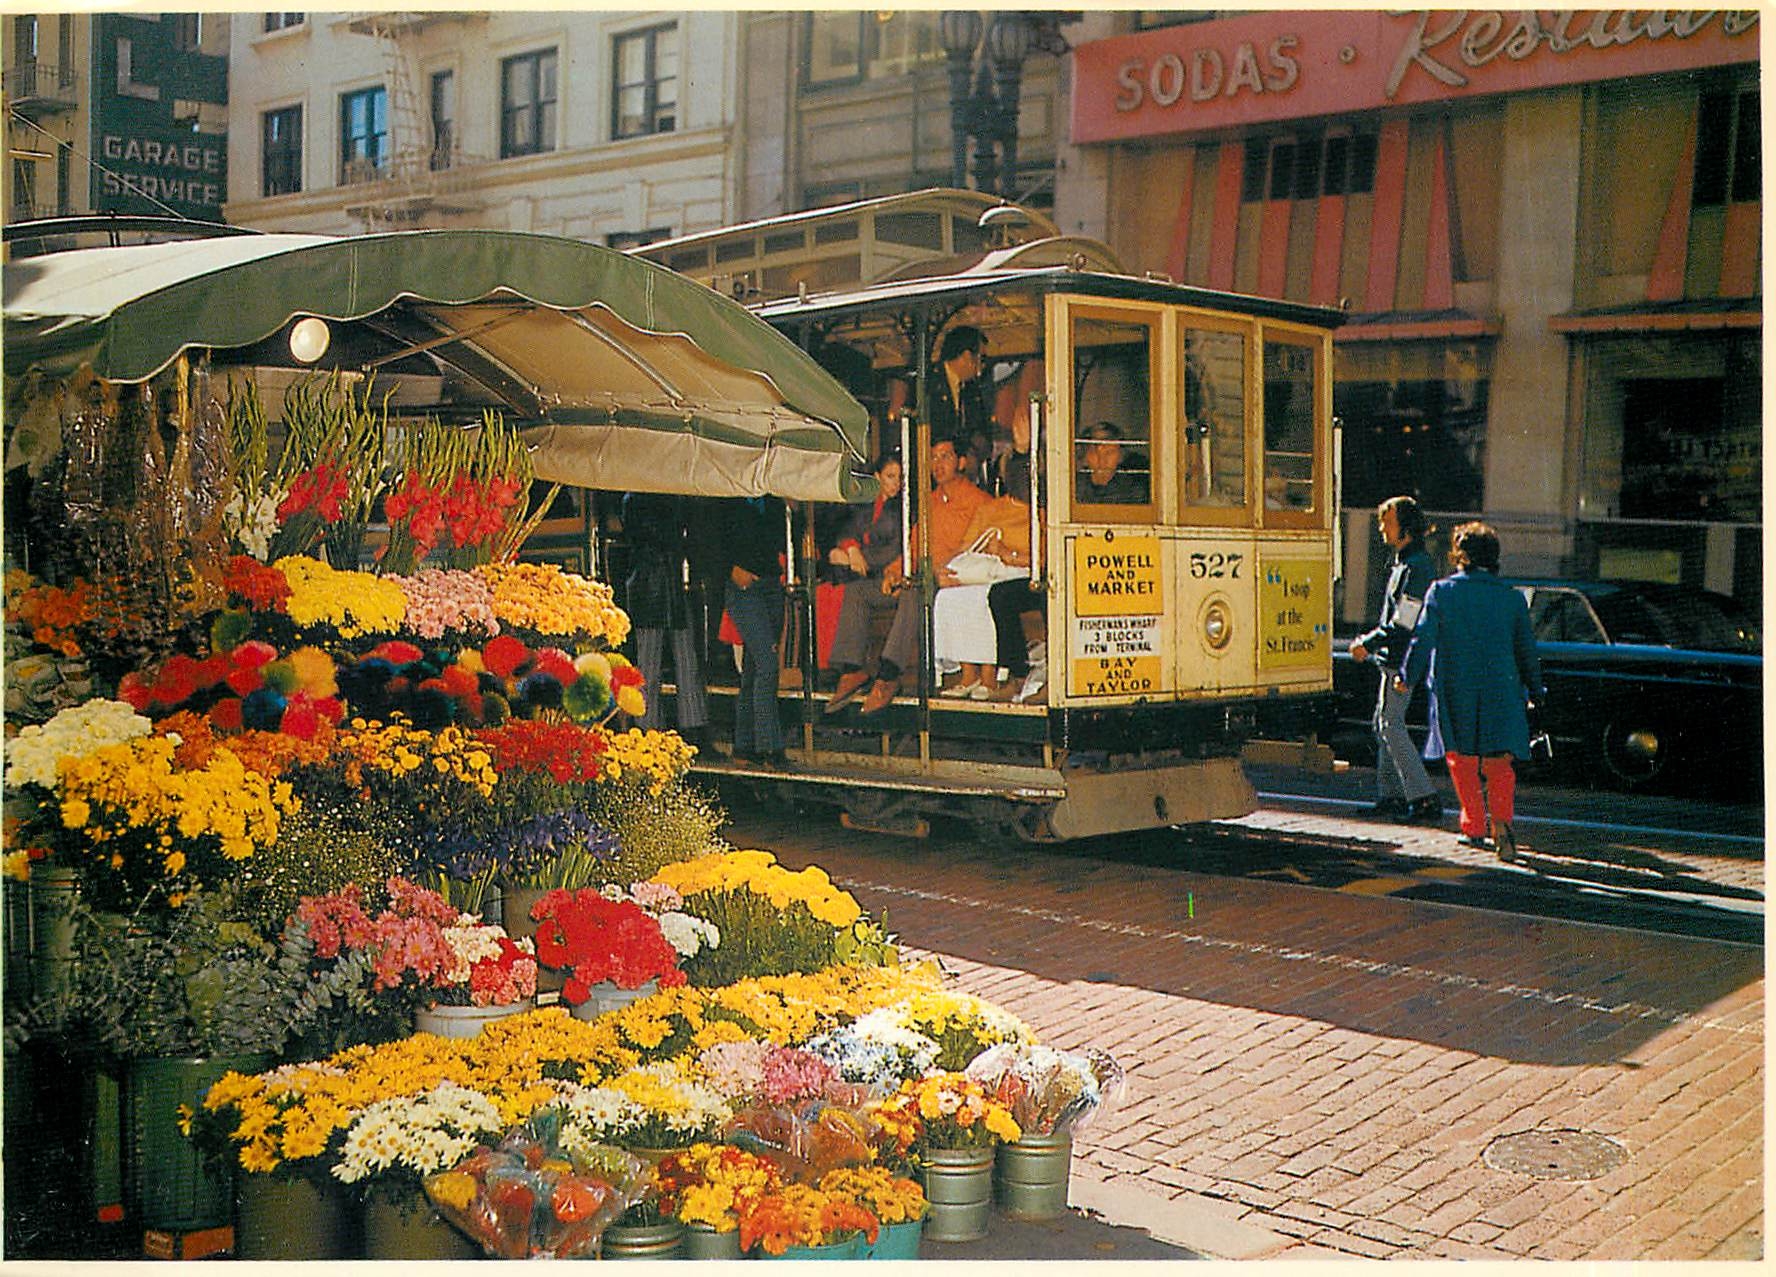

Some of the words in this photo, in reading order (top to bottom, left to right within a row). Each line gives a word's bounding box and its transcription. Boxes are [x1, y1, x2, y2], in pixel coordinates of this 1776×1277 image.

[1115, 35, 1300, 112] SODAS
[105, 136, 220, 173] GARAGE
[104, 172, 220, 203] SERVICE
[1087, 555, 1154, 568] POWELL
[1190, 553, 1243, 578] 527
[1107, 570, 1135, 580] AND
[1088, 581, 1154, 595] MARKET
[1290, 582, 1310, 600] stop
[1130, 617, 1157, 628] WHARF
[1277, 610, 1286, 625] at
[1287, 607, 1304, 624] the
[1094, 631, 1100, 642] 3
[1106, 631, 1144, 642] BLOCKS
[1085, 643, 1108, 654] FROM
[1100, 657, 1136, 669] BAY
[1106, 669, 1132, 679] AND
[1087, 678, 1152, 695] TAYLOR
